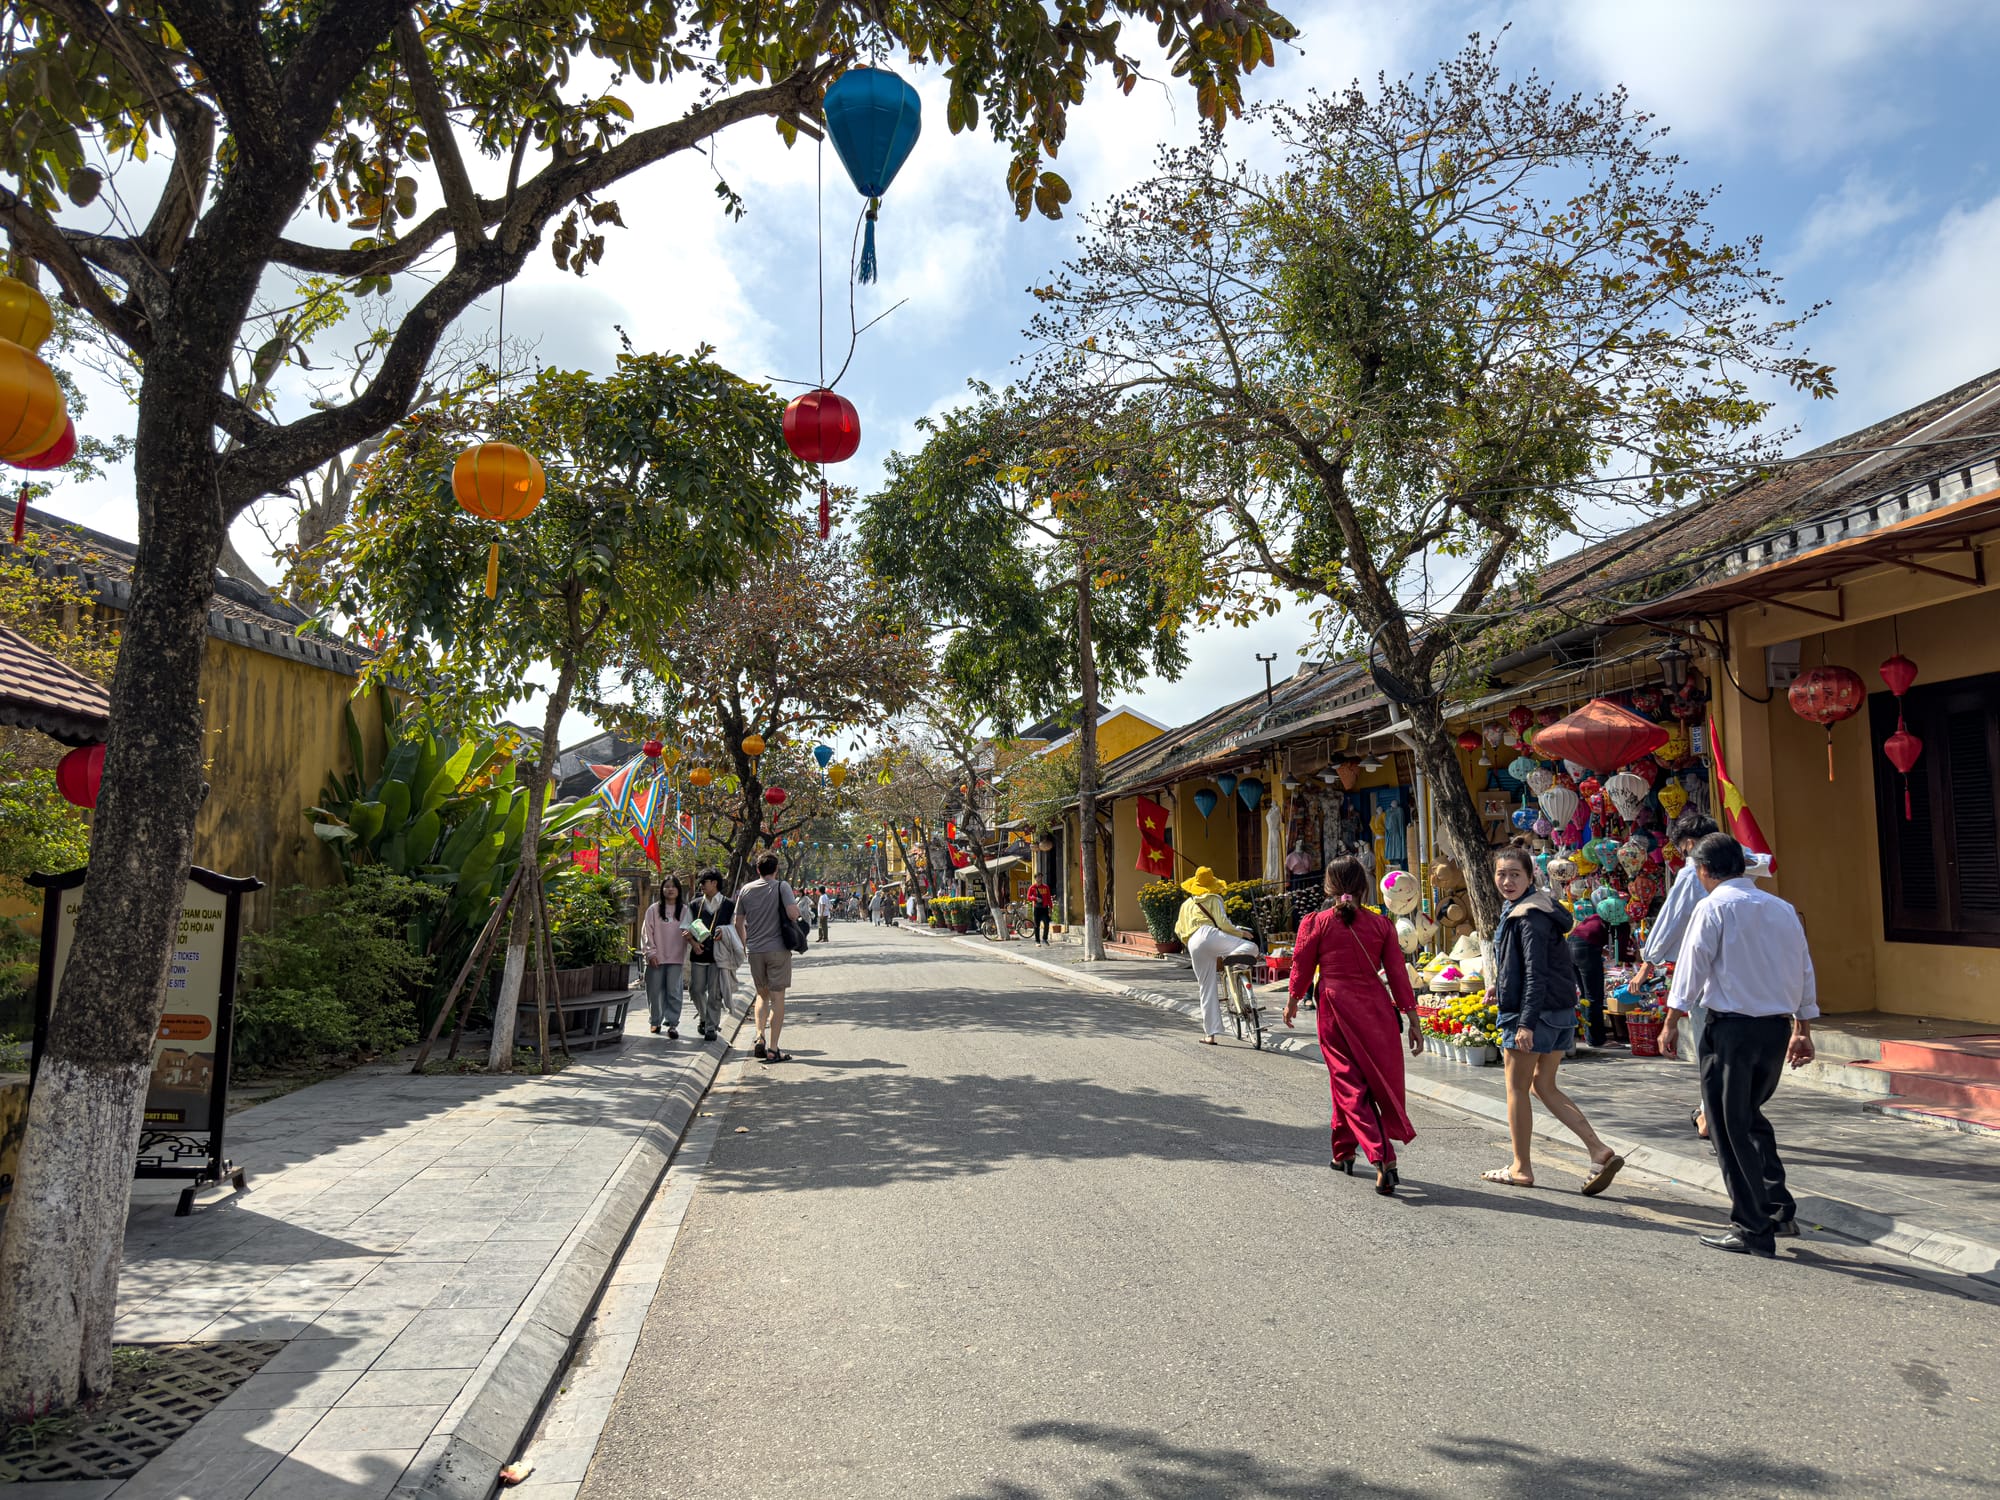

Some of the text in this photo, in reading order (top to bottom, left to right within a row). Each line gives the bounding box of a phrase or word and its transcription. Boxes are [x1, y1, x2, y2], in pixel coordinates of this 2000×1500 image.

[182, 909, 222, 920] THAM QUAN
[190, 922, 203, 934] HỘI
[204, 923, 214, 932] AN
[177, 934, 188, 944] IỚI
[178, 951, 199, 960] TICKETS
[174, 979, 186, 988] SITE
